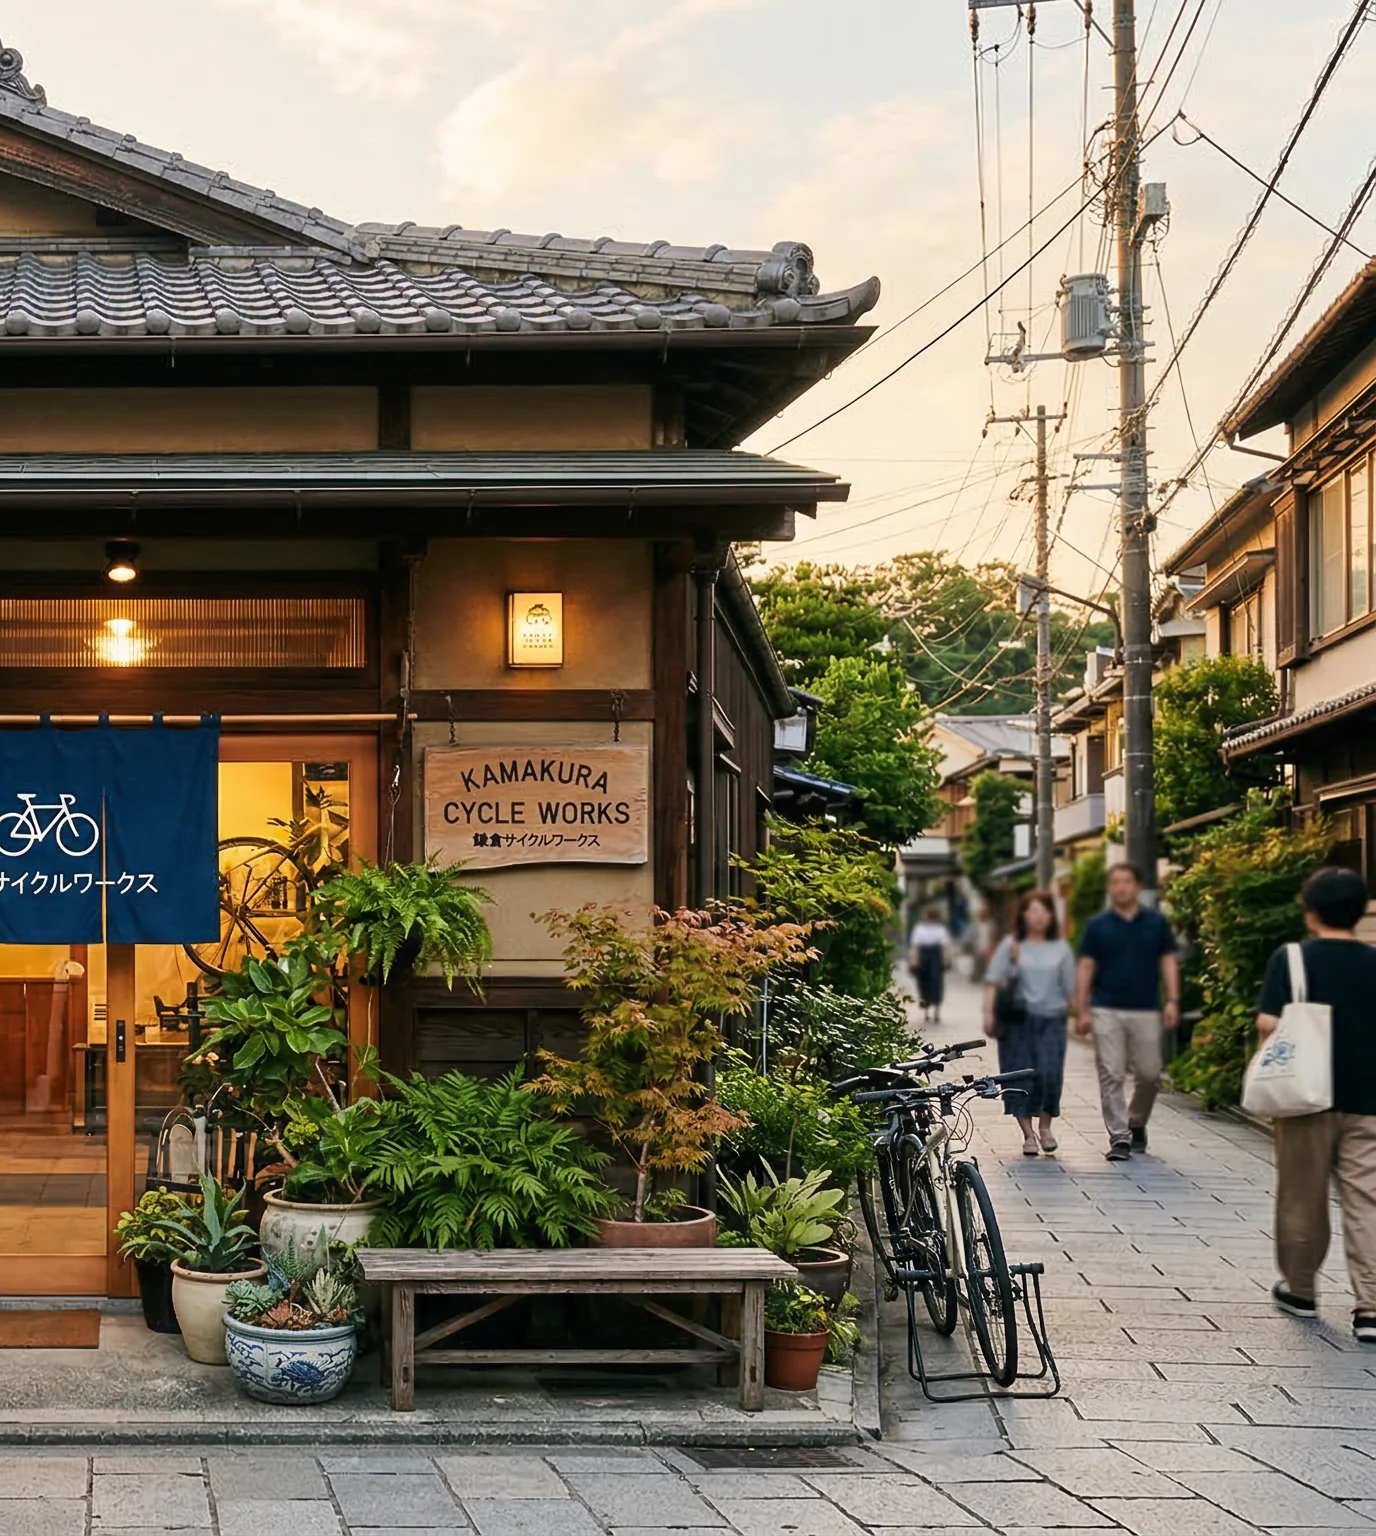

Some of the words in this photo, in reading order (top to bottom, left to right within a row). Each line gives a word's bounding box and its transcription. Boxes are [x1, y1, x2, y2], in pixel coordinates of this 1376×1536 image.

[460, 759, 608, 794] KAMAKURA
[443, 801, 525, 824] CYCLE
[538, 801, 630, 824] WORKS
